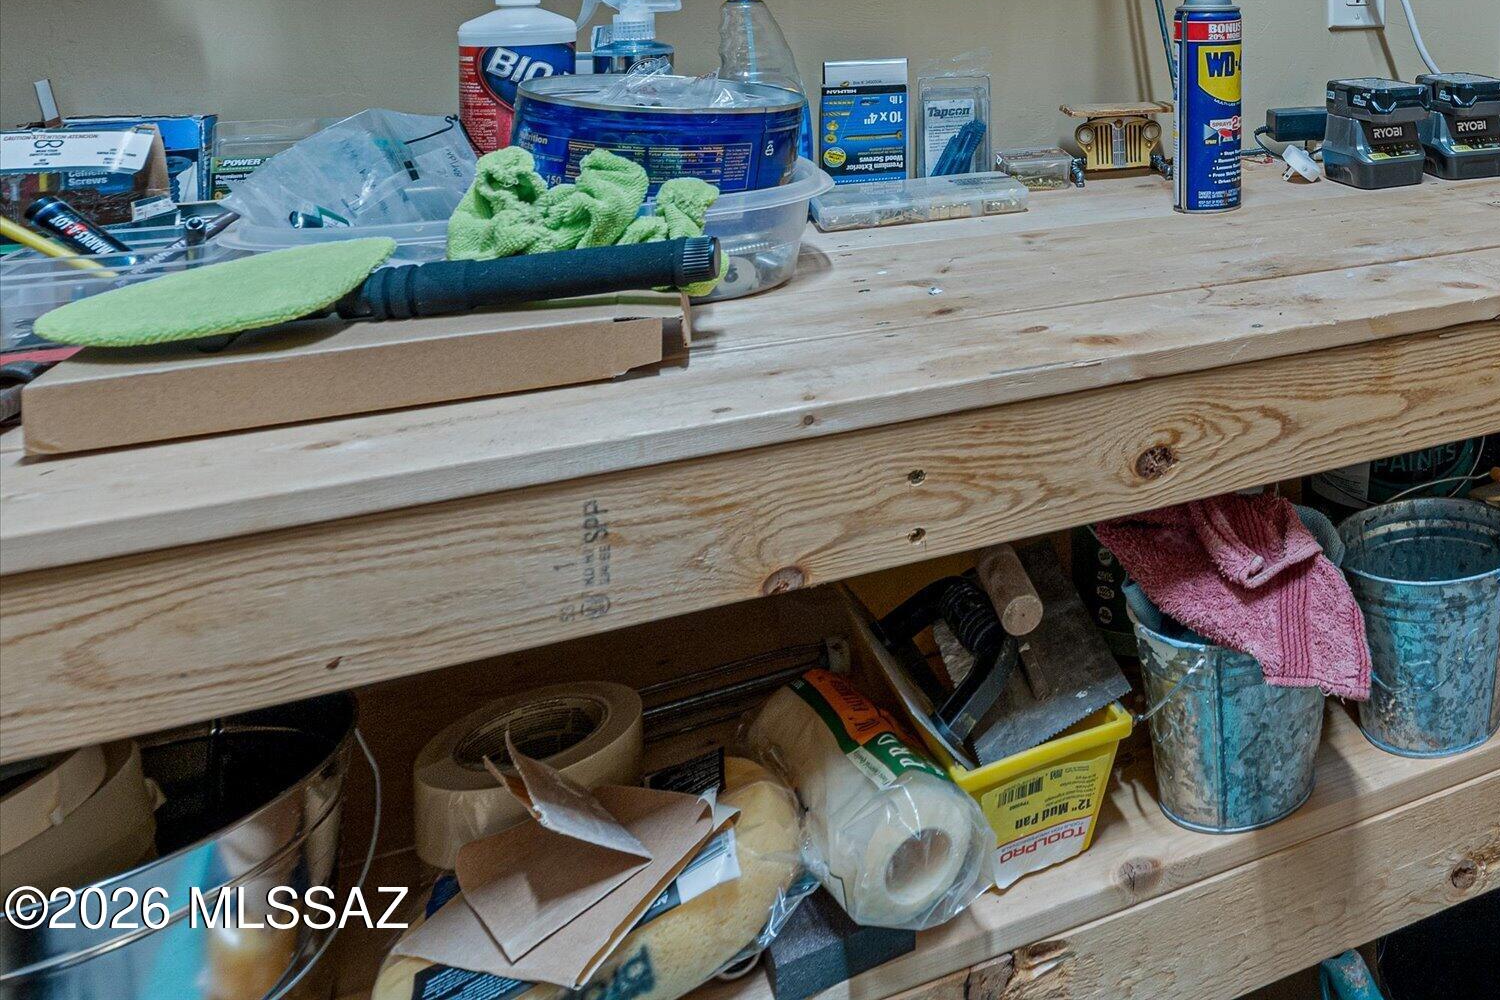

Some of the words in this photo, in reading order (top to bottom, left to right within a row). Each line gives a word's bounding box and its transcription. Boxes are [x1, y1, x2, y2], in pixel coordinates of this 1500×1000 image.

[1208, 22, 1241, 34] BONUS
[486, 47, 554, 83] BIO
[1205, 51, 1242, 78] WD-
[864, 112, 878, 125] 4"
[890, 110, 903, 122] 10
[928, 106, 972, 119] Tapcon
[1373, 126, 1402, 138] RYOBI
[1456, 120, 1486, 132] RYOBI
[222, 158, 261, 166] POWER
[884, 155, 904, 163] Wood
[846, 162, 873, 171] Exterior
[874, 162, 904, 171] Premium
[68, 177, 108, 186] Screws
[1374, 444, 1458, 473] PAINTS
[1071, 798, 1092, 812] 12"
[1042, 802, 1068, 822] Mud
[1014, 812, 1039, 830] Pan
[1000, 826, 1086, 864] TOOLPRO
